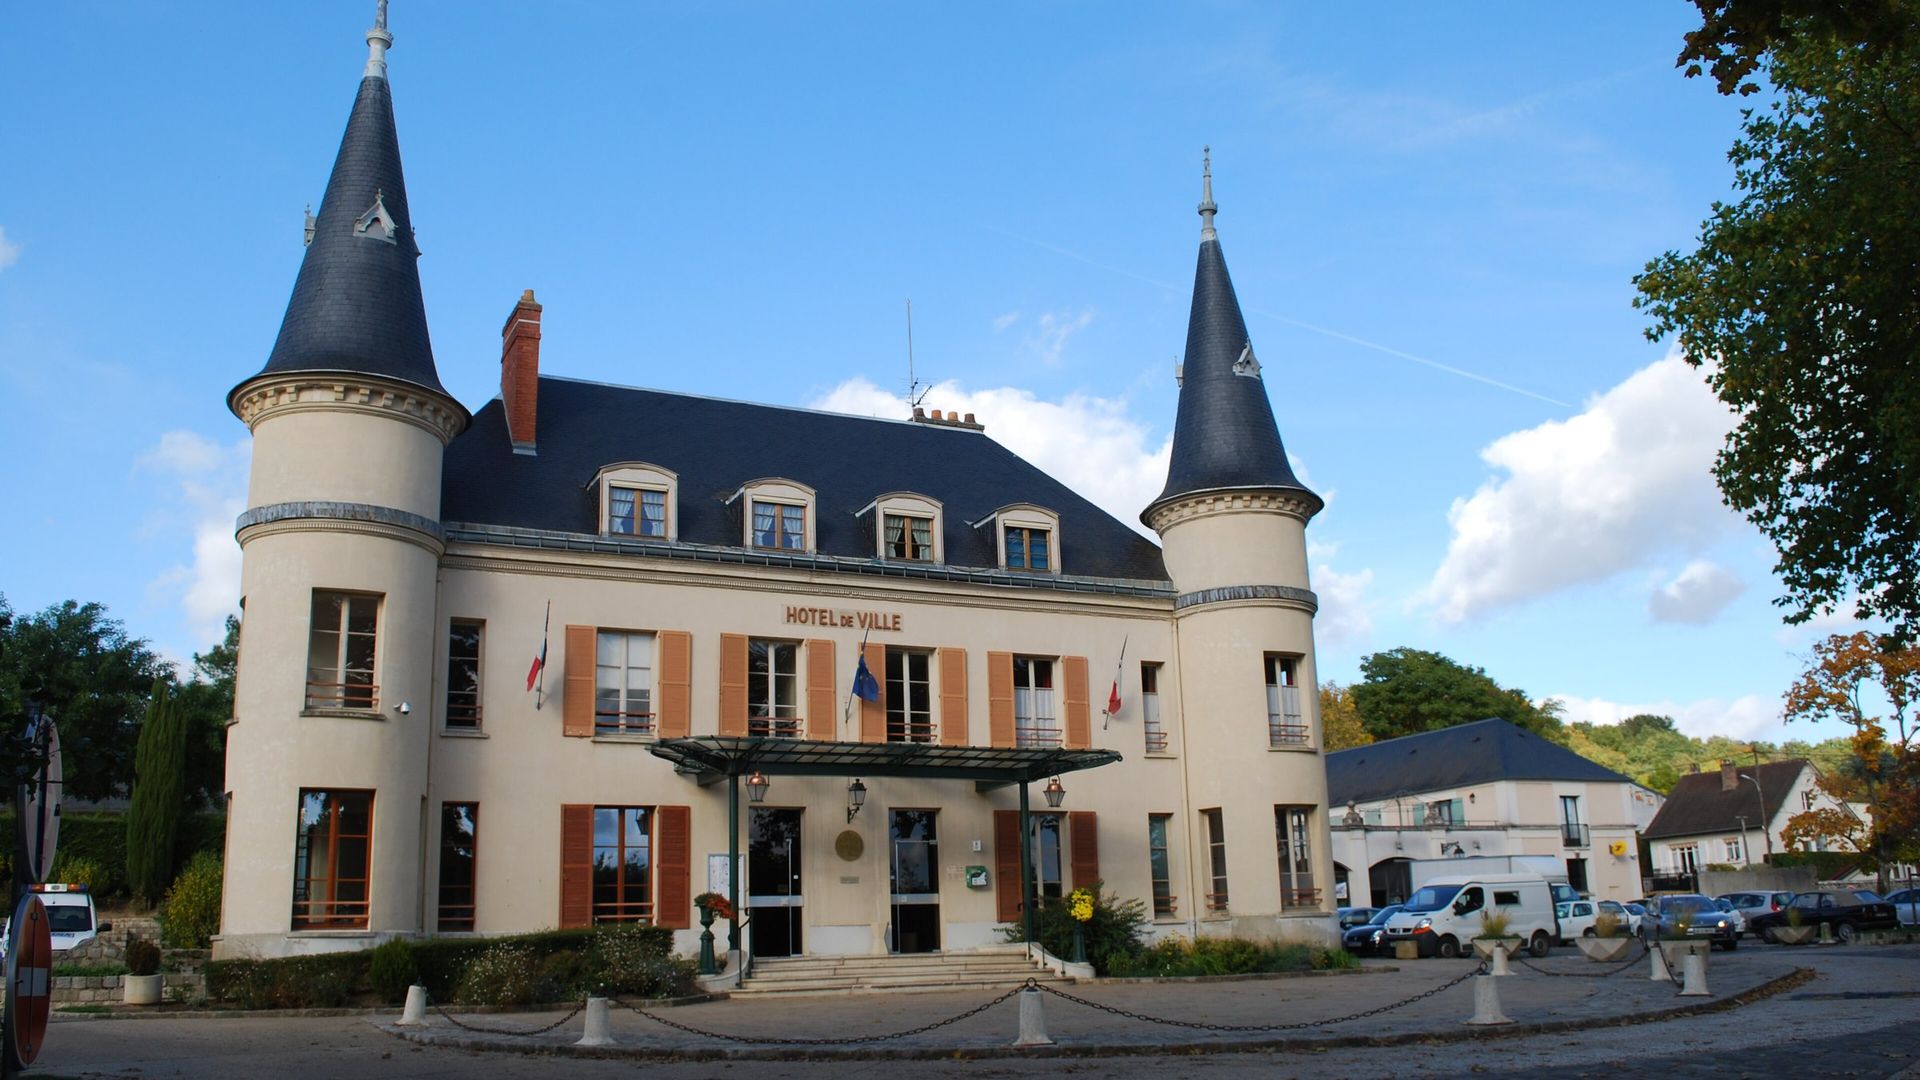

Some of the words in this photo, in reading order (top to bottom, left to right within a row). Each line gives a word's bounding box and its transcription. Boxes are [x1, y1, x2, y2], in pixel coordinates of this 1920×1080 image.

[786, 606, 838, 626] HOTEL
[840, 615, 854, 628] DE
[857, 611, 901, 631] VILLE
